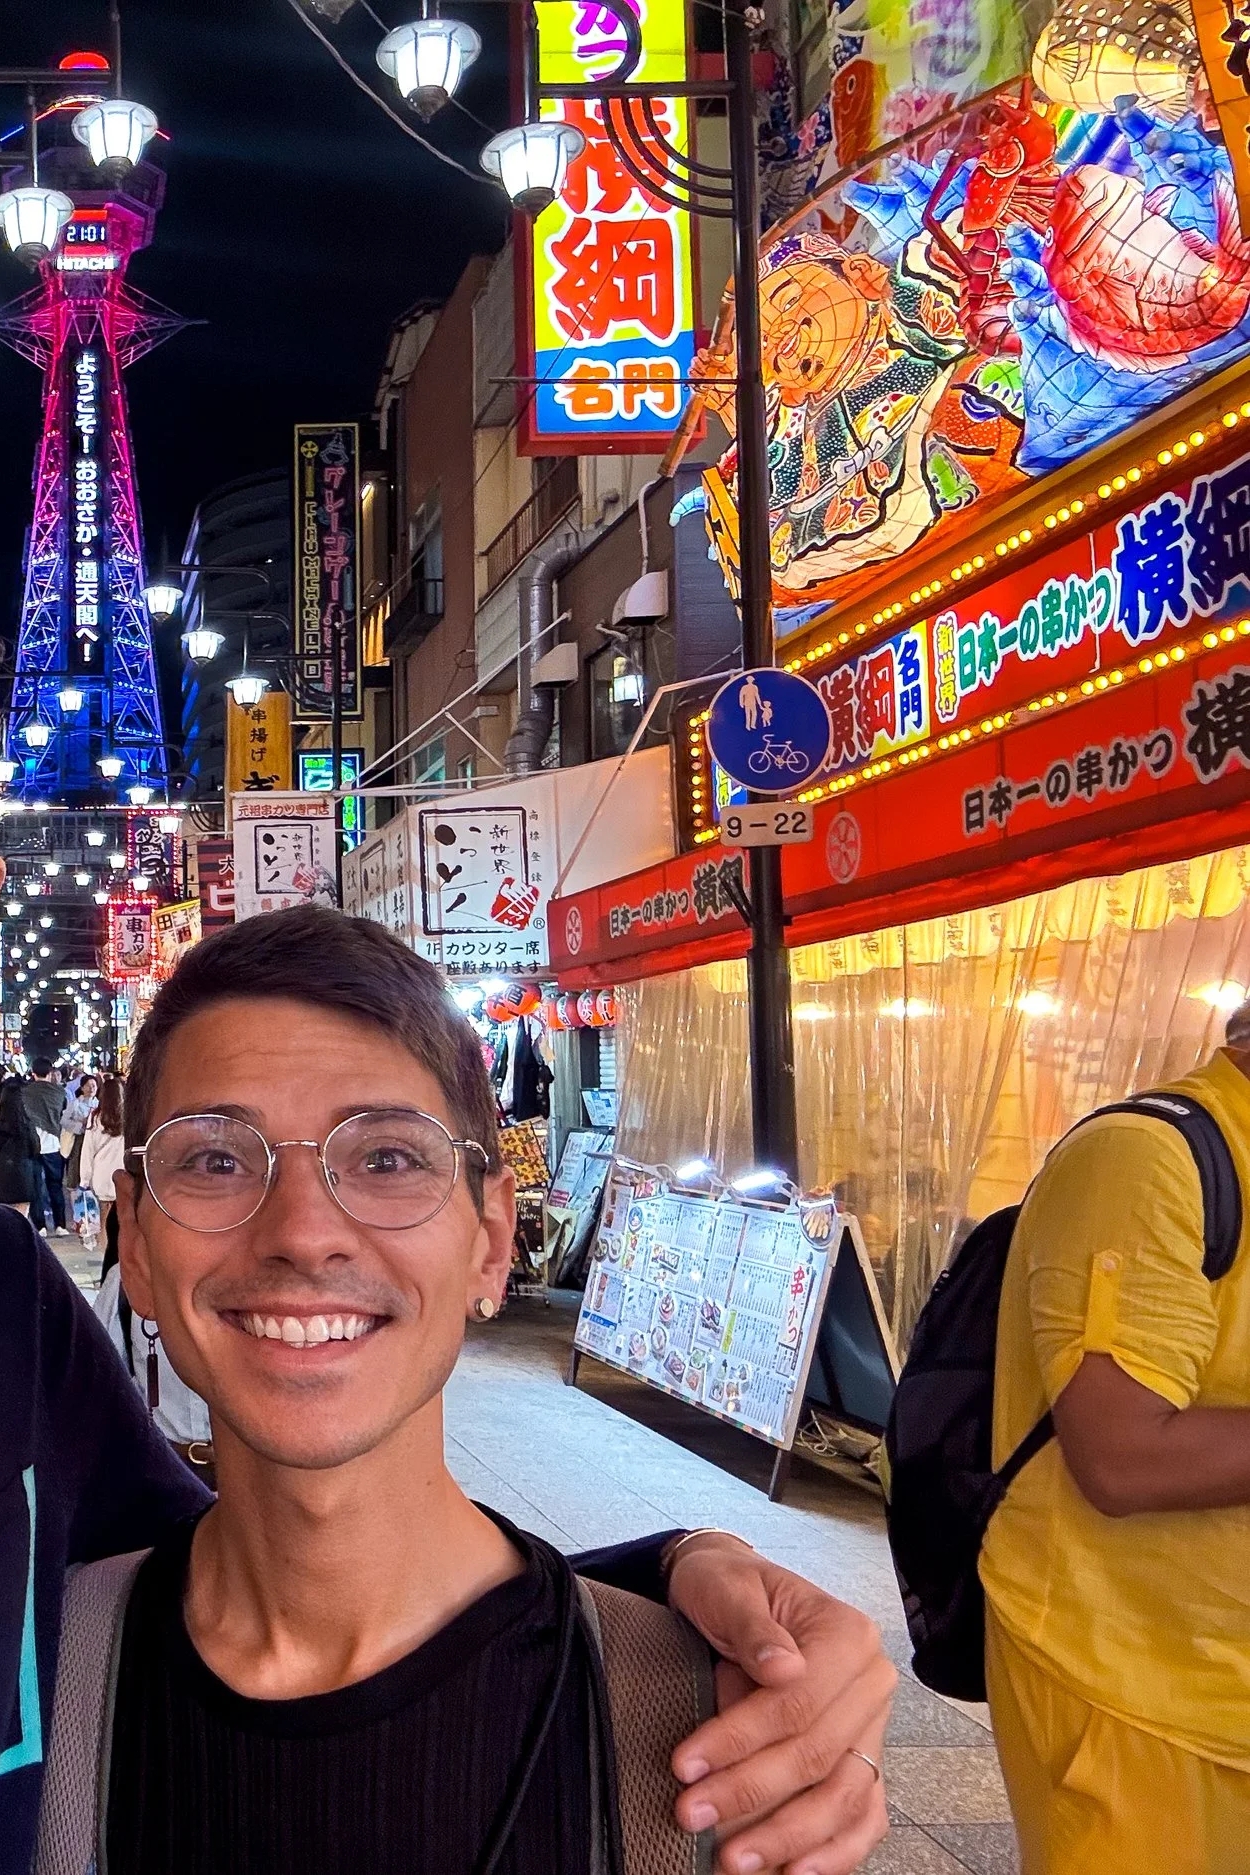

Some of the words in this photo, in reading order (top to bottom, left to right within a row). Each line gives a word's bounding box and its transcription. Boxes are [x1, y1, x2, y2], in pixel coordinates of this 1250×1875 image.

[66, 224, 106, 242] 21:01
[56, 256, 115, 271] HITACHI
[560, 363, 674, 416] 名門
[958, 574, 1113, 691] 日本一の串かつ
[898, 638, 922, 737] 名門
[963, 733, 1174, 833] 日本一の串かつ
[611, 890, 689, 937] 日本一の串かつ
